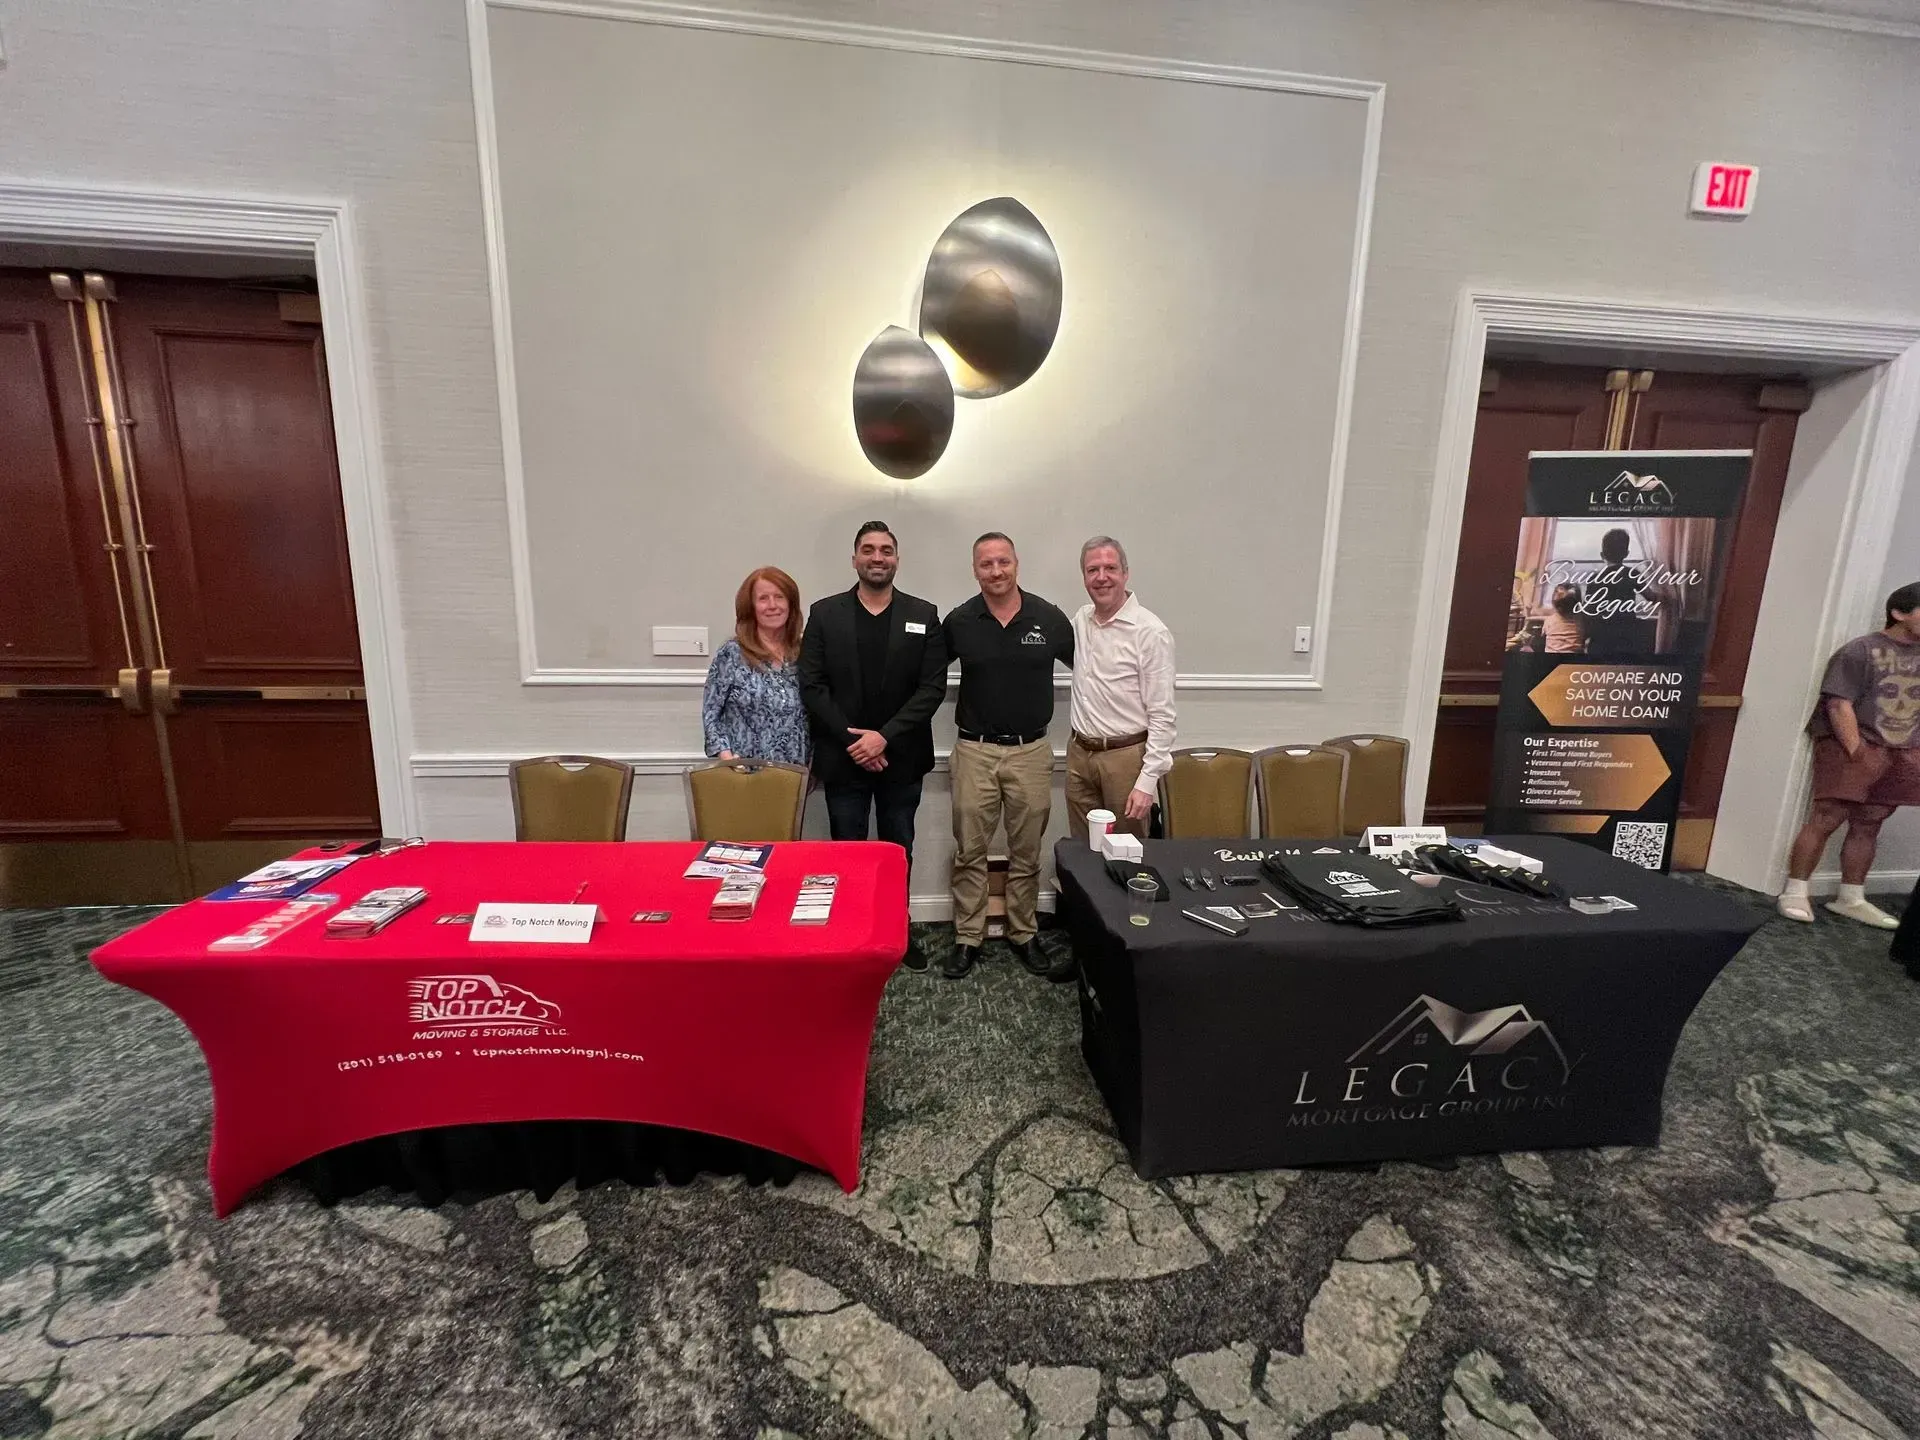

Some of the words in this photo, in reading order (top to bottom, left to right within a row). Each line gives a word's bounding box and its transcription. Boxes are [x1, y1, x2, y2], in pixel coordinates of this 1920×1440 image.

[1706, 166, 1752, 208] EXIT
[1589, 491, 1677, 505] LEGACY
[1540, 560, 1625, 586] Build
[1629, 560, 1703, 593] Your
[1573, 587, 1662, 619] Legacy
[1569, 671, 1645, 685] COMPARE
[1648, 672, 1682, 685] AND
[1565, 688, 1606, 701] SAVE
[1609, 689, 1634, 701] ON
[1639, 689, 1681, 702] YOUR
[1572, 705, 1619, 718] HOME
[1622, 706, 1670, 719] LOAN!
[1523, 737, 1545, 747] Our
[1548, 737, 1600, 750] Expertise
[1589, 751, 1612, 759] Buyers
[1594, 761, 1633, 769] Responders
[1528, 779, 1570, 787] Refinancing
[1553, 789, 1582, 797] Lending
[511, 917, 527, 928] Top
[529, 917, 555, 928] Notch
[556, 918, 589, 929] Moving
[420, 980, 479, 1000] TOP
[420, 999, 527, 1021] NOTCH
[412, 1029, 467, 1040] MOVING
[470, 1028, 479, 1038] &
[482, 1027, 539, 1038] STORAGE
[337, 1058, 373, 1072] (201)
[378, 1050, 443, 1065] 518-0169
[473, 1046, 645, 1062] topnotchmovingnj.com
[1293, 1052, 1588, 1106] LEGACY
[1285, 1102, 1433, 1128] MORTGAGE
[1438, 1096, 1526, 1118] GROUP
